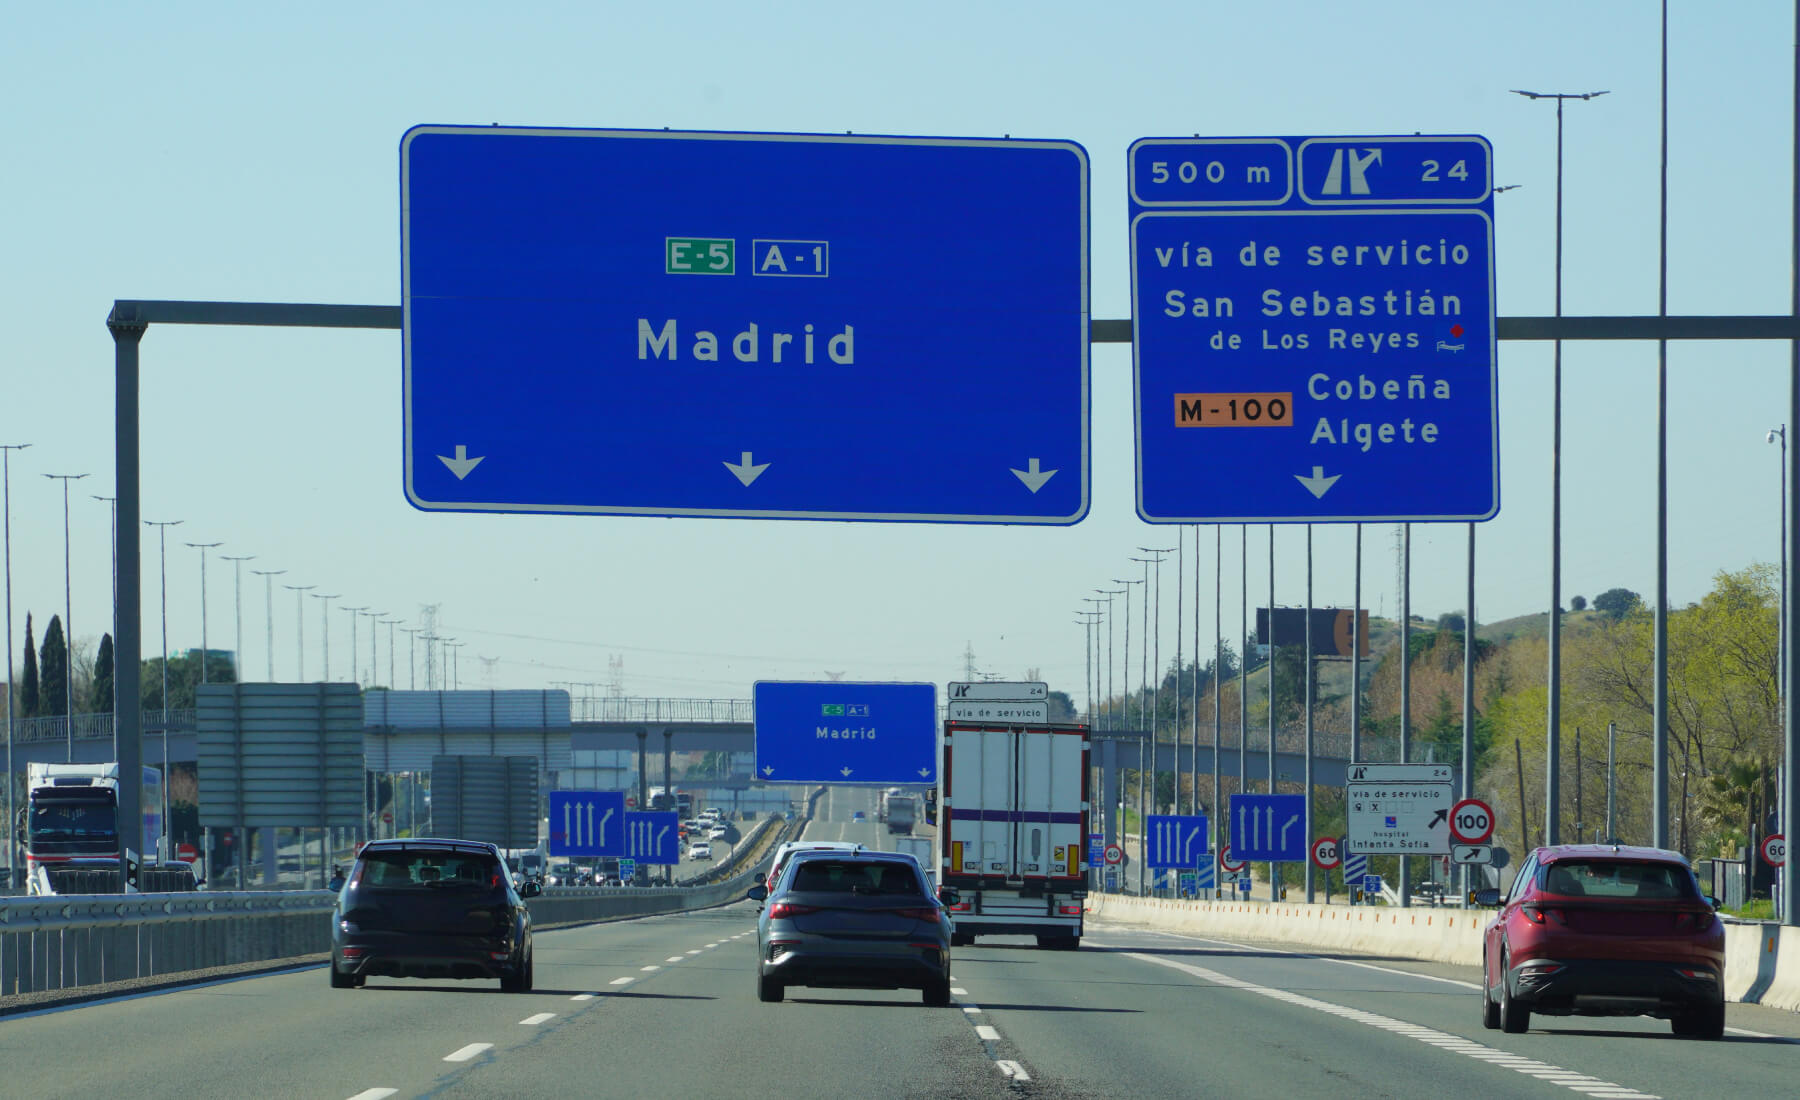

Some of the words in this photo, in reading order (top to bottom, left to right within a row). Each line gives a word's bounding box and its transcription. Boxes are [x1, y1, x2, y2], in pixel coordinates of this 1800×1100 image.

[1152, 161, 1225, 184] 500
[1246, 166, 1271, 183] m
[1421, 159, 1469, 182] 24
[671, 242, 729, 270] E-5
[761, 244, 822, 272] A-1
[1154, 241, 1213, 268] vía
[1239, 240, 1281, 267] de
[1306, 238, 1470, 266] servicio
[1164, 289, 1233, 318] San
[1261, 288, 1462, 317] Sebastián
[637, 318, 855, 365] Madrid
[1209, 330, 1242, 350] de
[1262, 329, 1310, 350] Los
[1329, 328, 1420, 354] Reyes
[1307, 372, 1451, 401] Cobeña
[1180, 398, 1287, 422] M-100
[1310, 416, 1440, 453] Algete
[816, 726, 876, 740] Madrid
[1433, 769, 1448, 777] 24
[1374, 790, 1387, 798] de
[1391, 790, 1440, 798] servicio
[1456, 815, 1488, 830] 100
[1319, 847, 1336, 858] 60
[1769, 845, 1785, 856] 60
